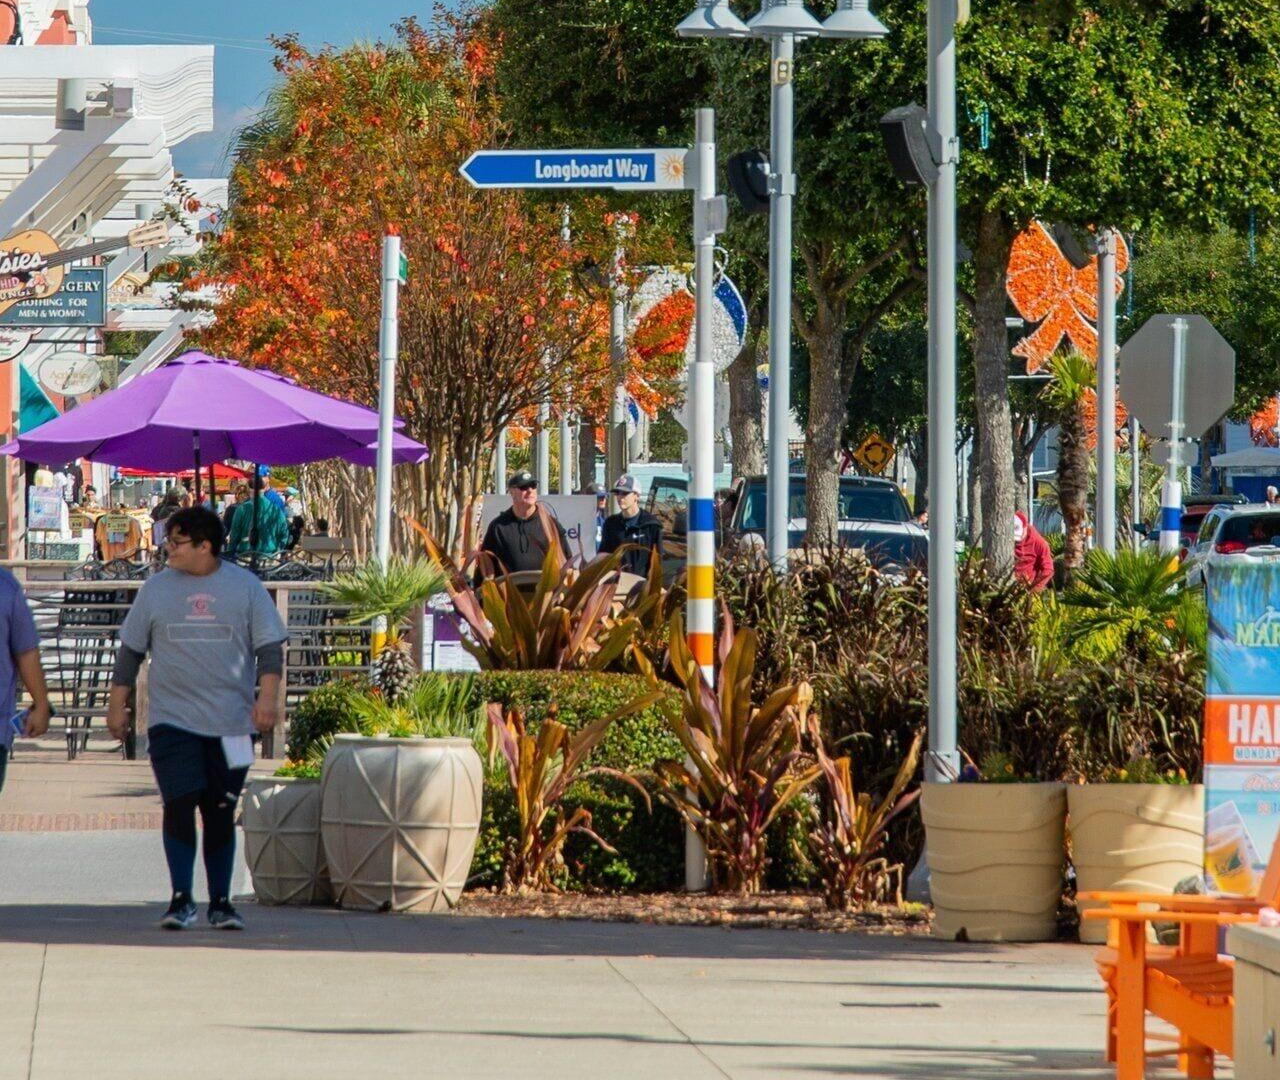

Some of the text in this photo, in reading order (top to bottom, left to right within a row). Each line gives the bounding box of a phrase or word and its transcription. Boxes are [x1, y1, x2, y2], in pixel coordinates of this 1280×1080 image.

[535, 157, 649, 182] Longboard Way
[68, 297, 88, 308] FOR
[18, 307, 86, 318] MEN & WOMEN
